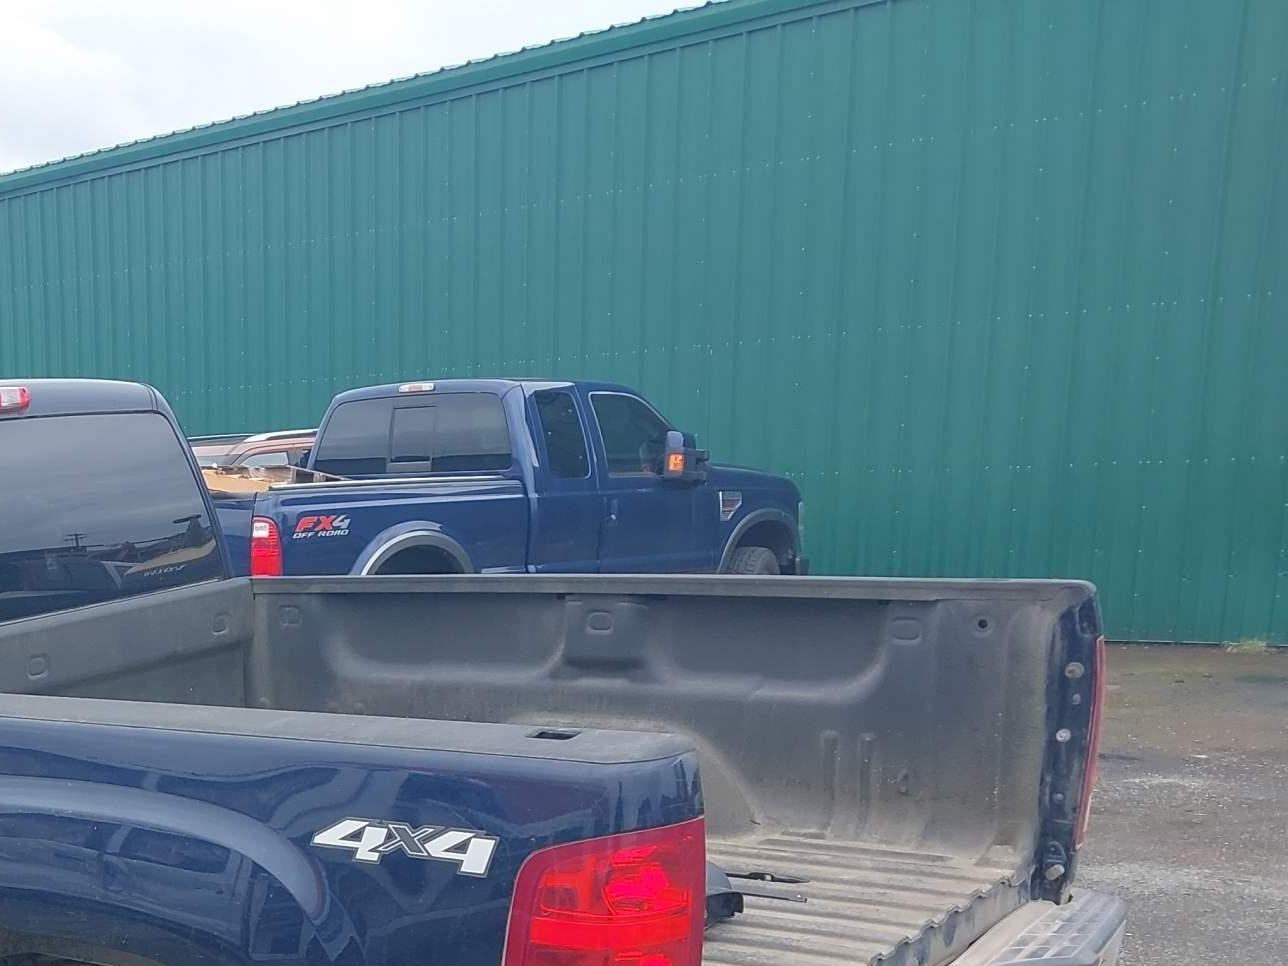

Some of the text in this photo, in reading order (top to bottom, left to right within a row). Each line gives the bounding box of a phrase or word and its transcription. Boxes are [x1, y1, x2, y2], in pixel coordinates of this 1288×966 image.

[294, 514, 352, 532] FX4
[292, 529, 350, 539] OFF ROAD
